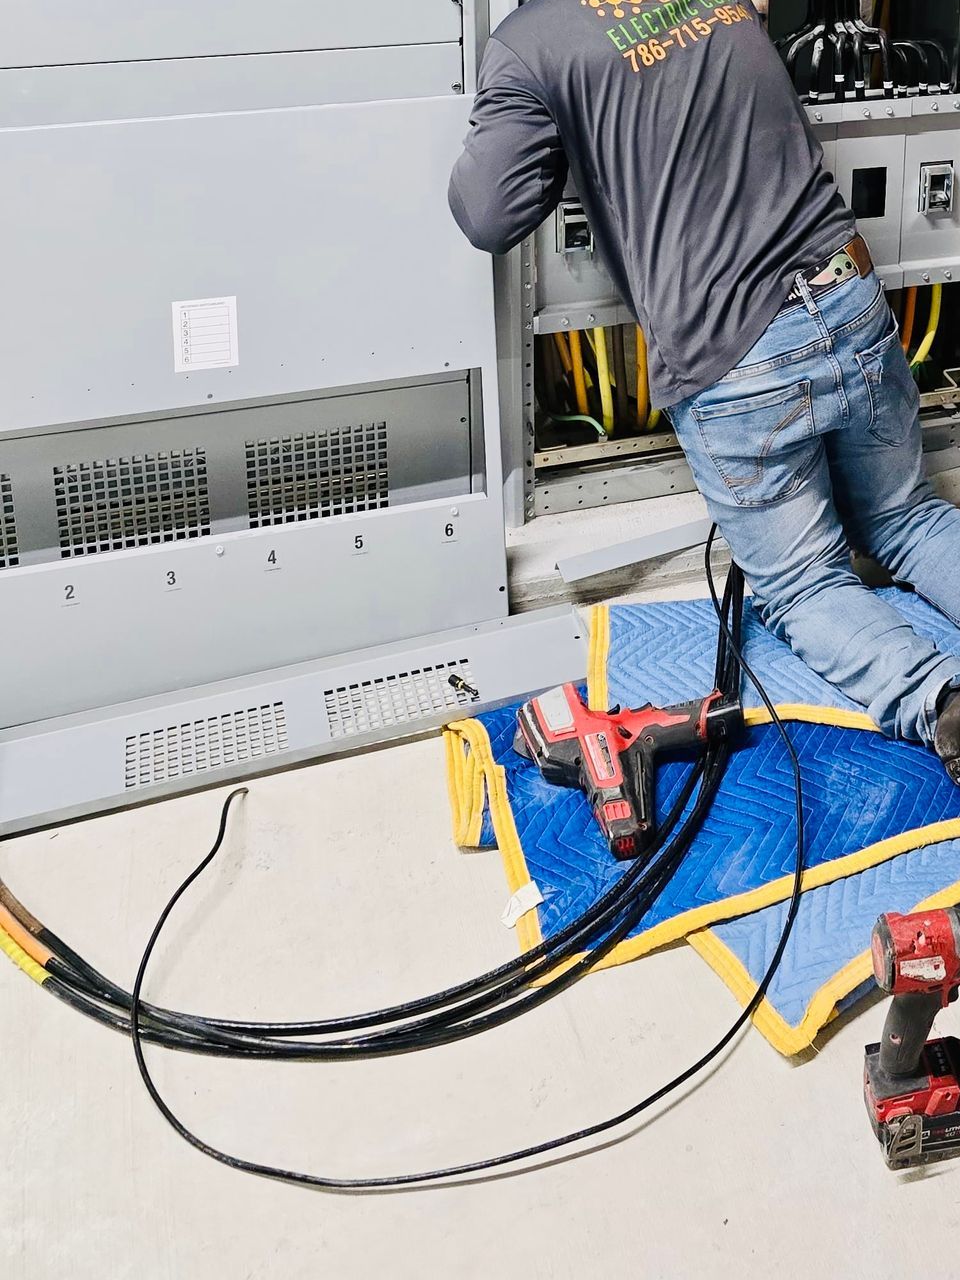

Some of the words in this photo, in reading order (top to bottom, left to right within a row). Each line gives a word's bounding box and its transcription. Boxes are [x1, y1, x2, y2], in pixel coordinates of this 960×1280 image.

[444, 523, 454, 537] 6
[354, 535, 364, 550] 5
[267, 549, 277, 565] 4
[166, 570, 176, 586] 3
[64, 584, 75, 600] 2
